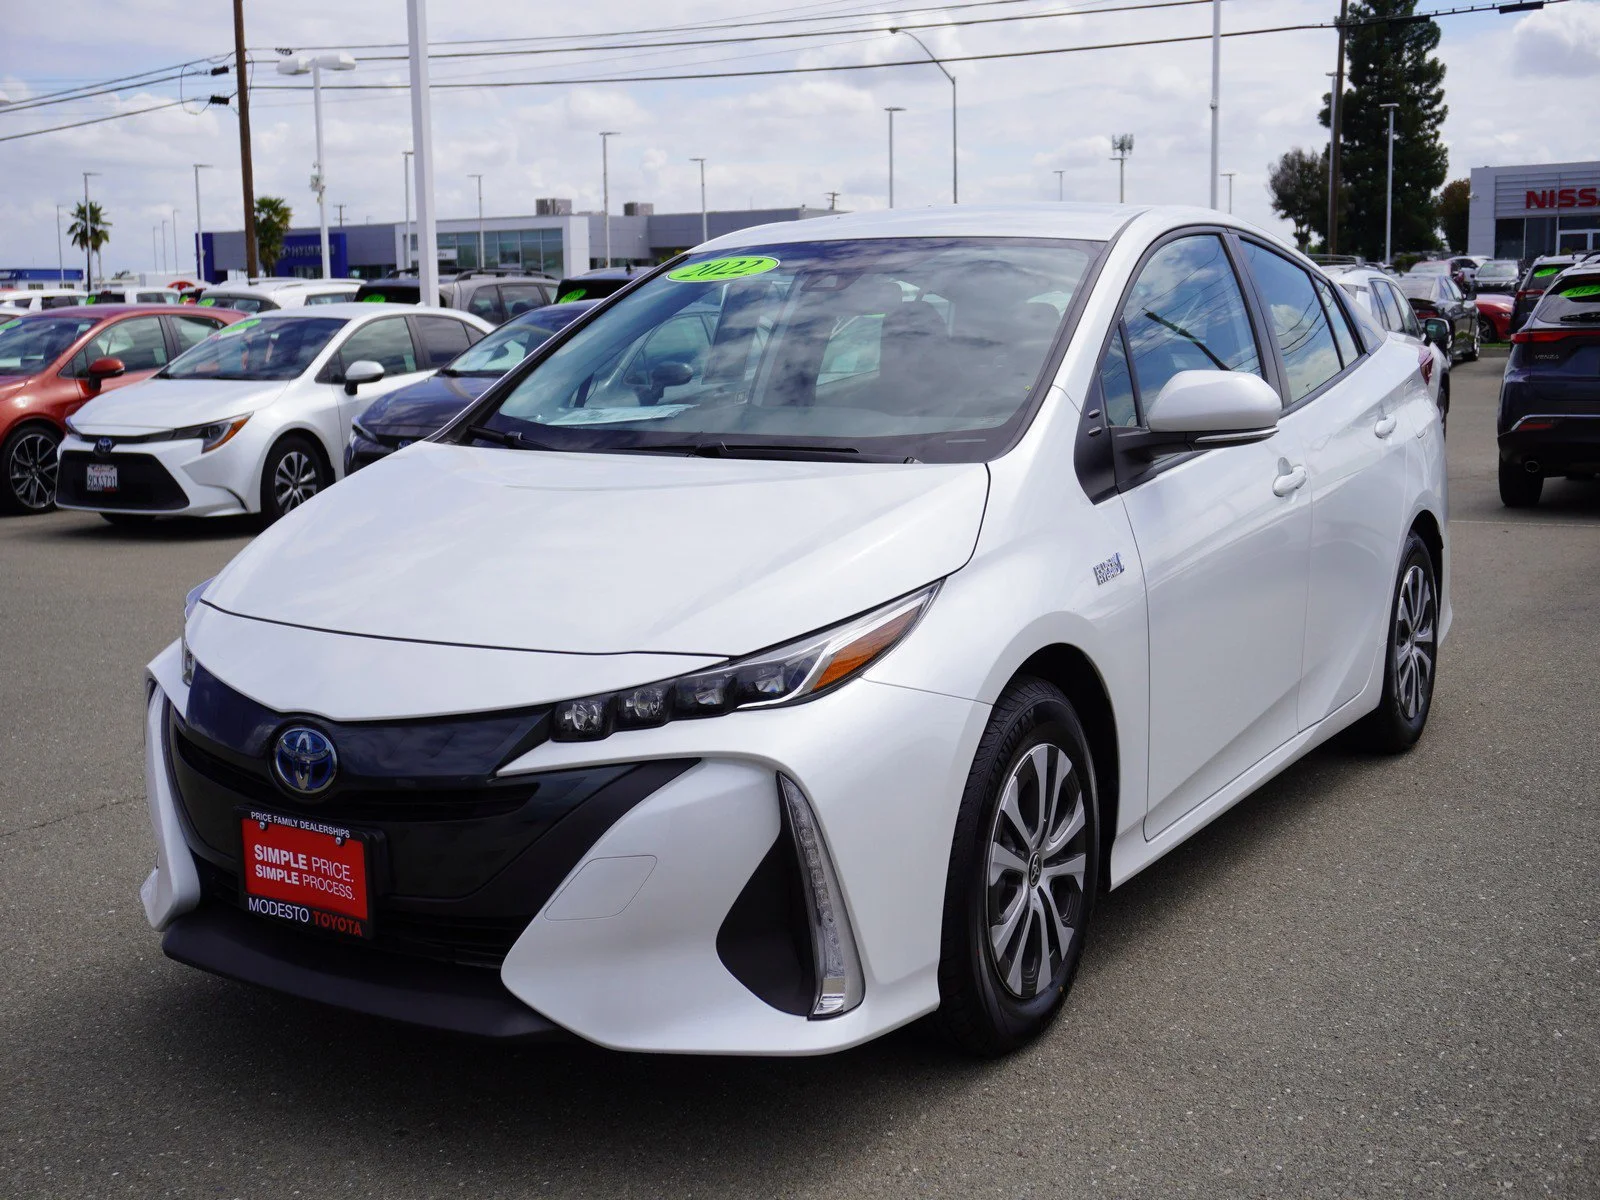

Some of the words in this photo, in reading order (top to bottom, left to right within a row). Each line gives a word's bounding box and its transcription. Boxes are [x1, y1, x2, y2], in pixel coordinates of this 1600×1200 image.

[1526, 188, 1600, 209] NISS
[677, 260, 764, 279] 2022
[251, 811, 272, 823] PRICE
[273, 815, 298, 828] FAMILY
[300, 820, 350, 838] DEALERSHIPS
[254, 844, 308, 870] SIMPLE
[311, 856, 354, 883] PRICE.
[255, 864, 300, 885] SIMPLE
[302, 874, 356, 900] PROCESS.
[248, 897, 309, 922] MODESTO
[313, 910, 362, 936] TOYOTA
